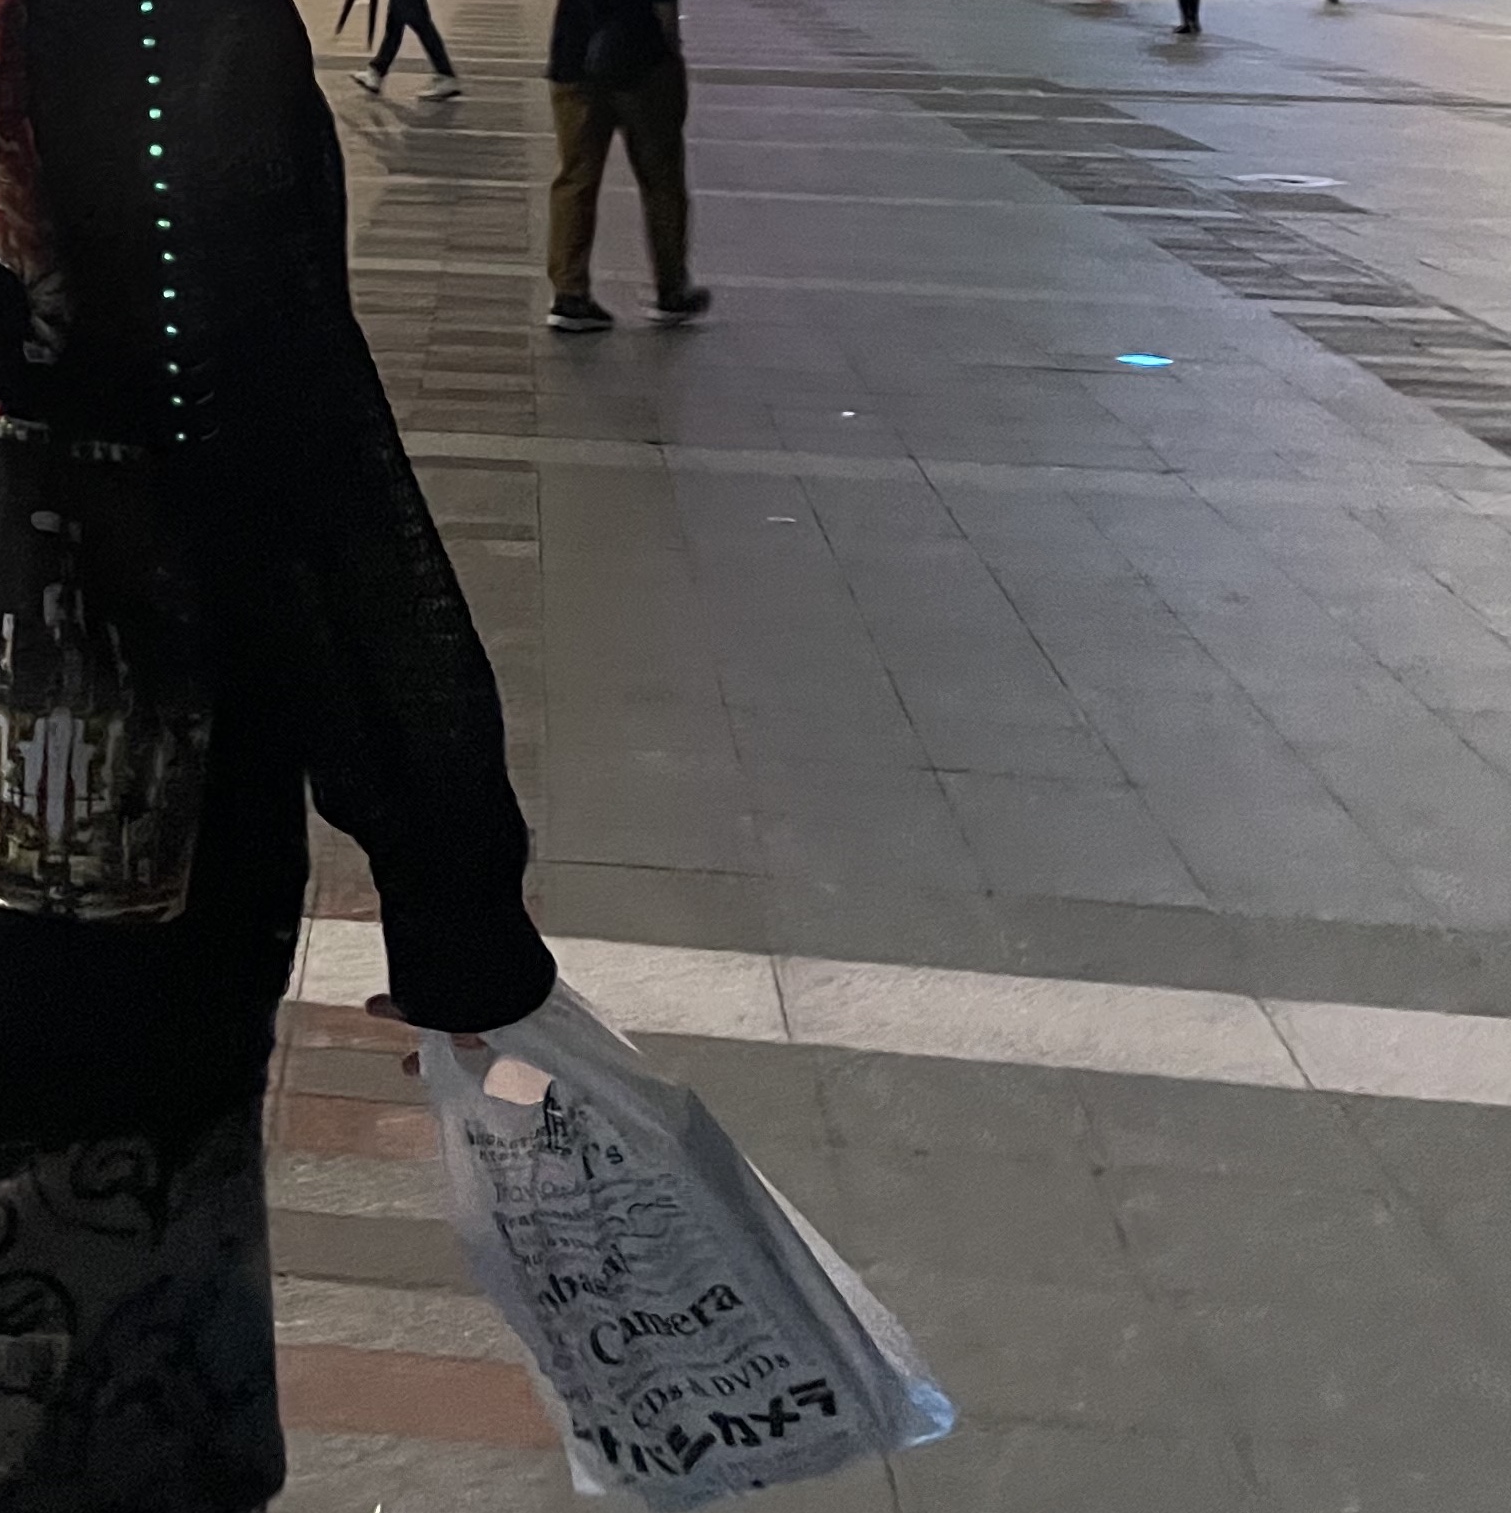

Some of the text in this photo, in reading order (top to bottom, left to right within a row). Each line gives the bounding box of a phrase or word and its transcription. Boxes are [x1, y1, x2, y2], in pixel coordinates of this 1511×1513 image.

[590, 1284, 744, 1365] Camera
[572, 1377, 838, 1476] ドバシカメラ
